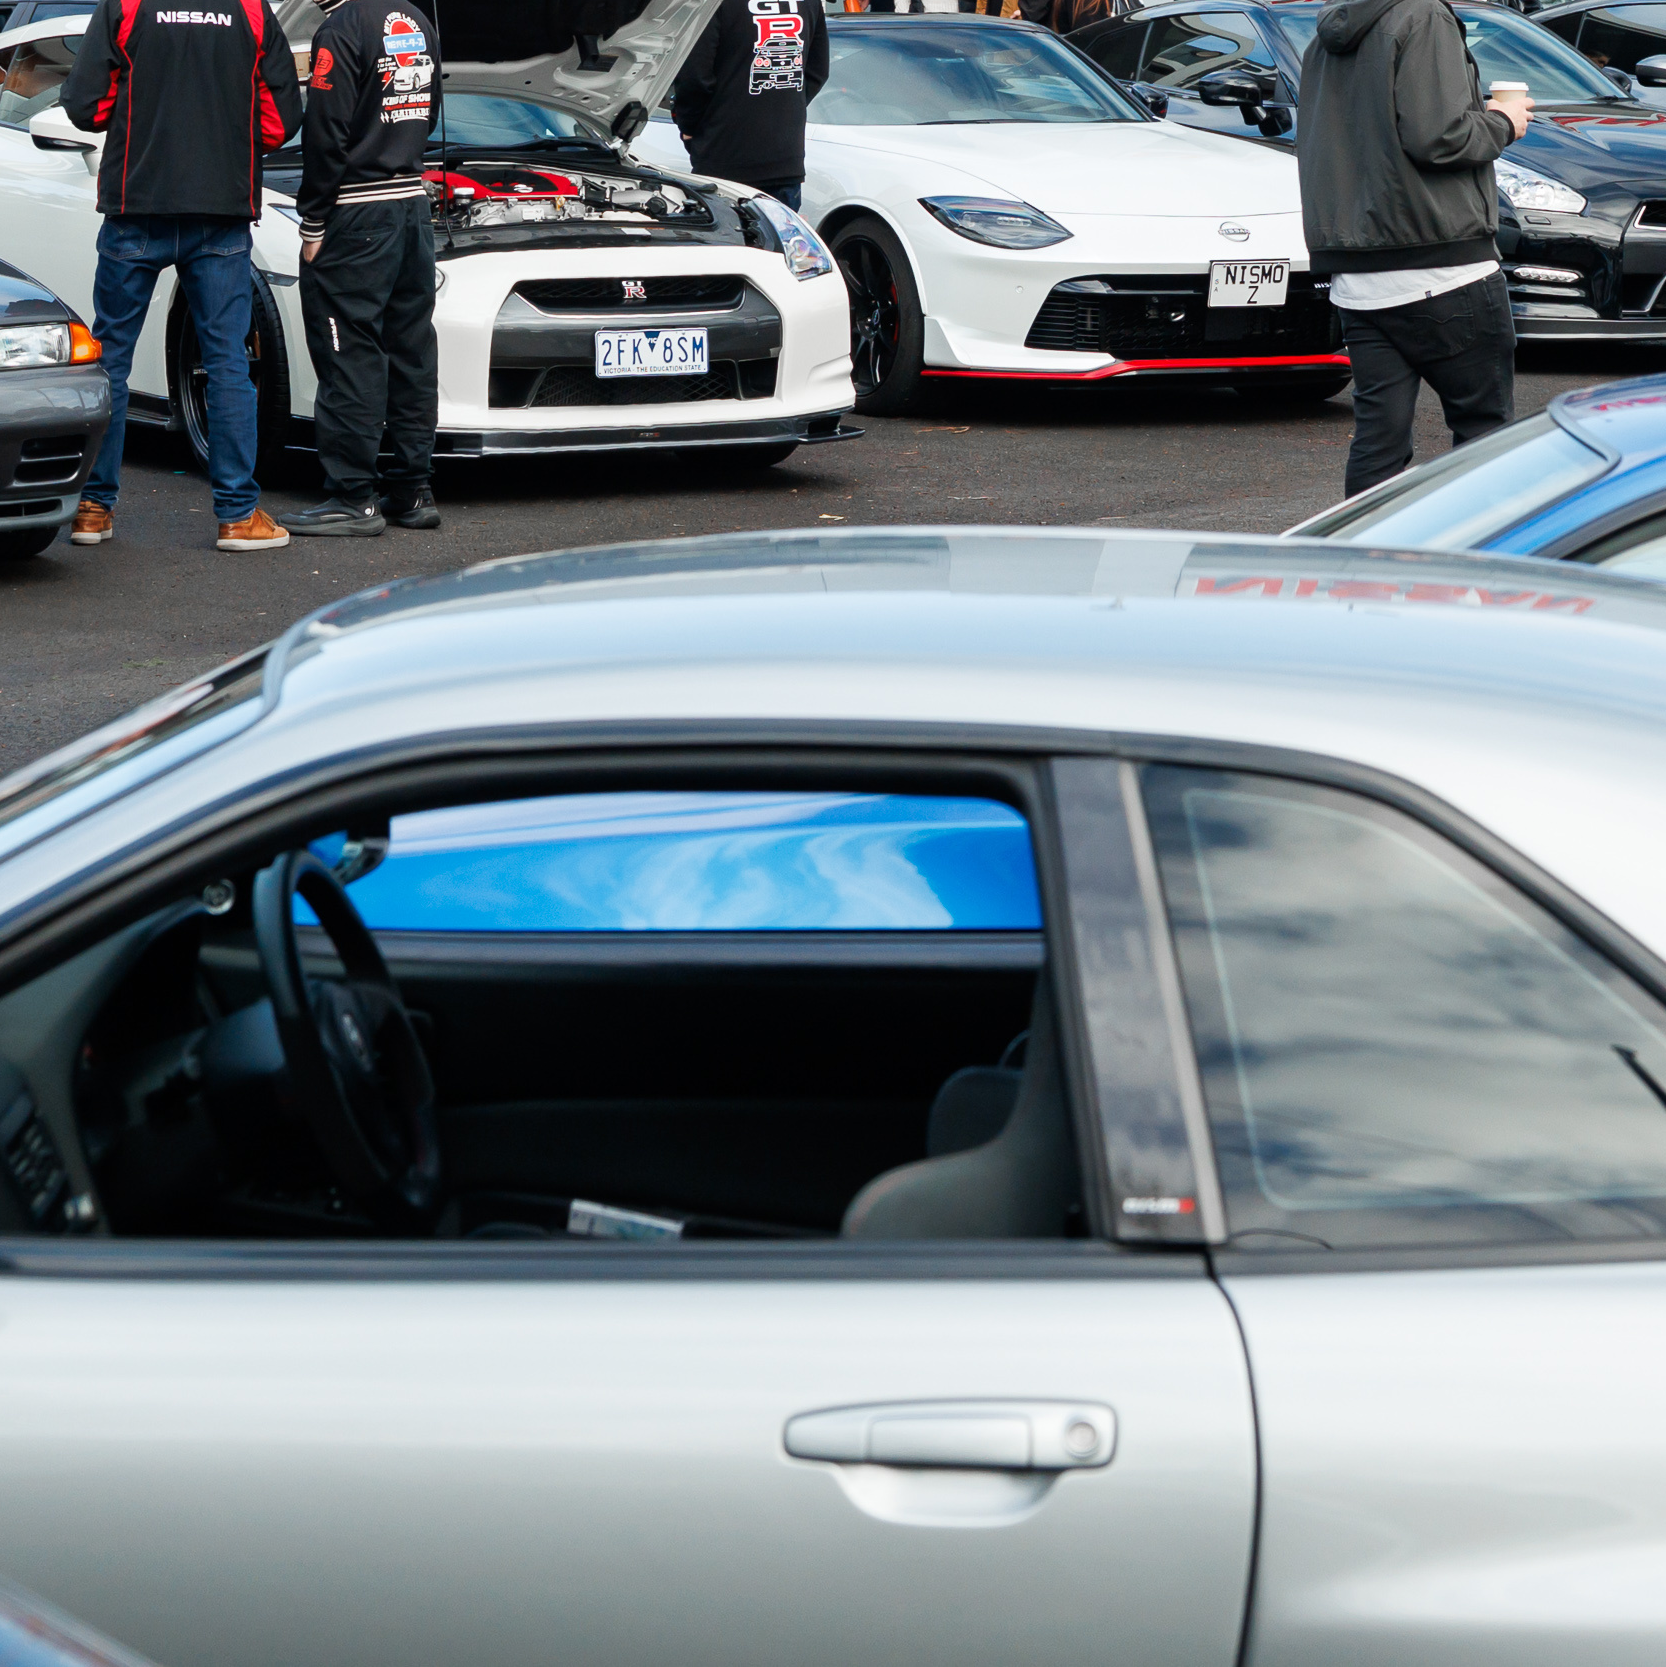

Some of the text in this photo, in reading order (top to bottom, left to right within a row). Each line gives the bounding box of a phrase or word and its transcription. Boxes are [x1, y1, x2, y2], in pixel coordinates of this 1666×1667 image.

[156, 11, 232, 27] NISSAN
[753, 14, 805, 48] R
[1225, 264, 1284, 285] NISMO
[623, 286, 647, 299] R
[1247, 285, 1259, 304] Z
[602, 336, 704, 366] 2FK 8SM
[649, 365, 683, 373] EDUCATION
